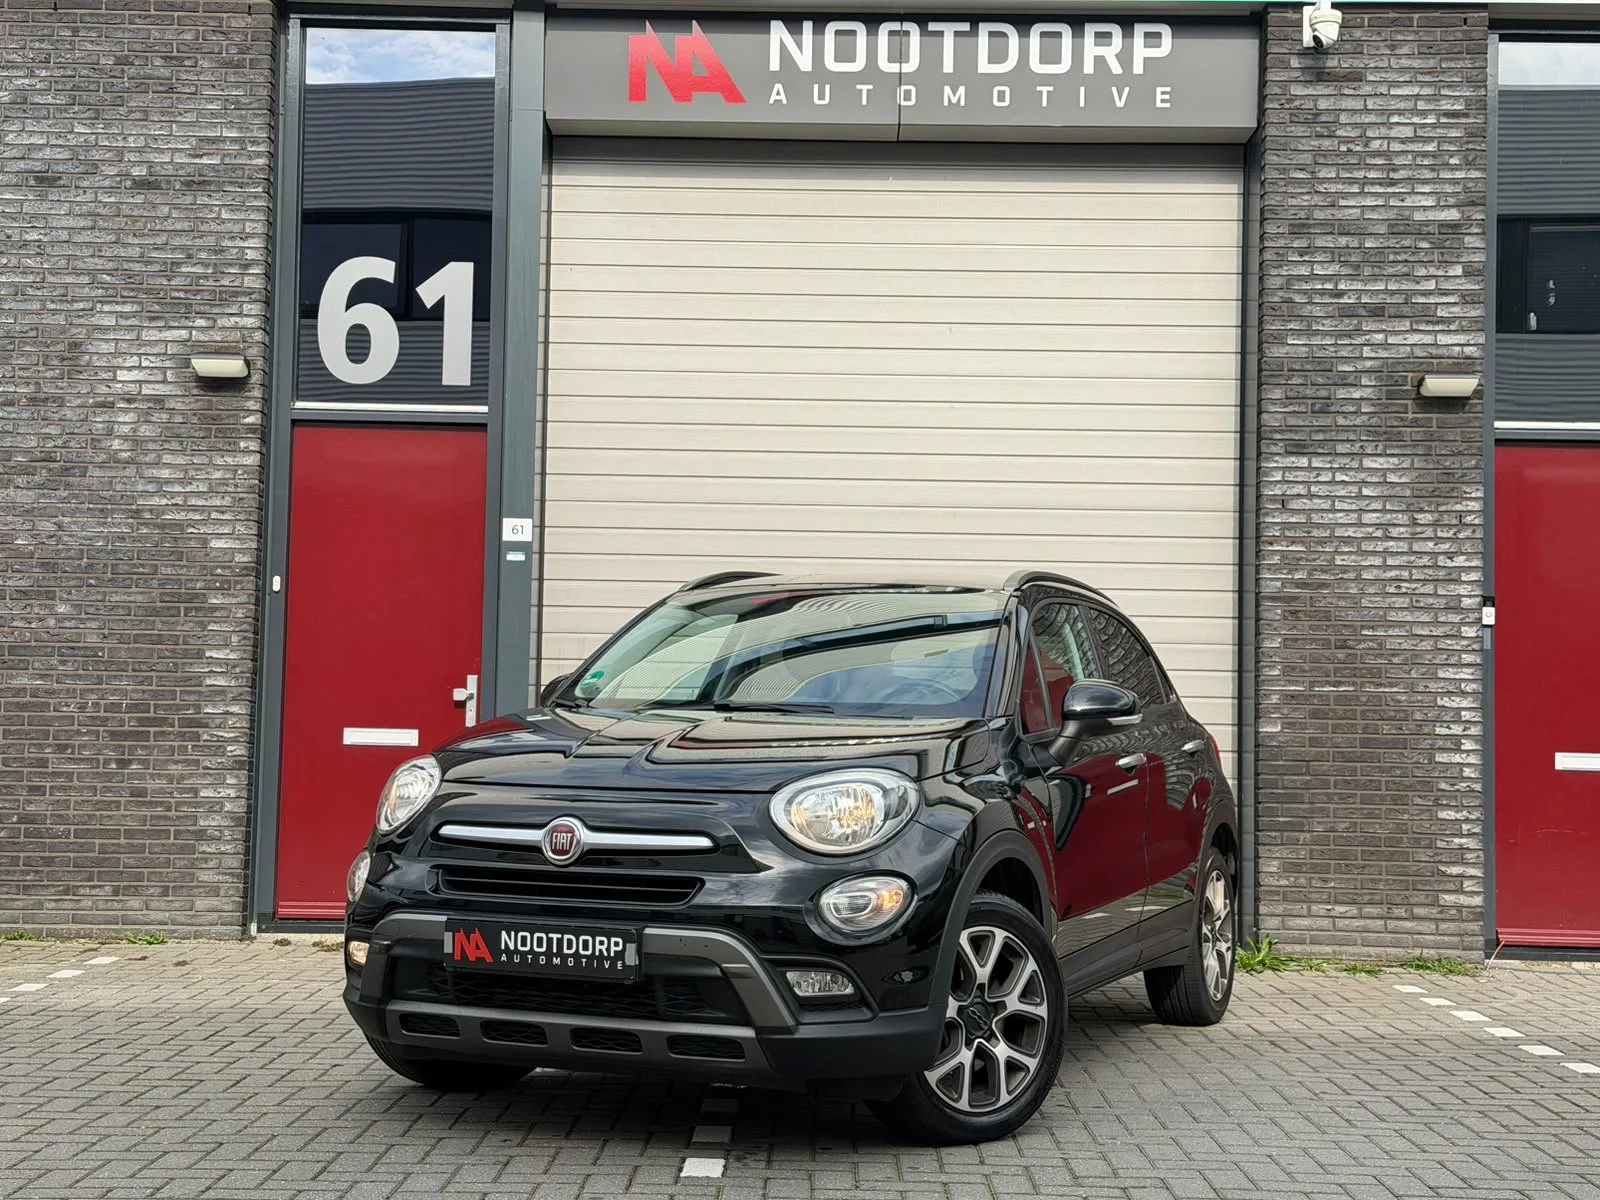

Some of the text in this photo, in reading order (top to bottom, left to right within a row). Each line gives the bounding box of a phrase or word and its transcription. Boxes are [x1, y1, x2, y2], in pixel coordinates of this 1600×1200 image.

[769, 19, 1173, 75] NOOTDORP
[768, 83, 1173, 108] AUTOMOTIVE
[317, 255, 475, 386] 61
[511, 524, 524, 535] 61
[551, 832, 573, 850] FIAT
[500, 930, 624, 957] NOOTDORP
[500, 953, 624, 970] AUTOMOTIVE
